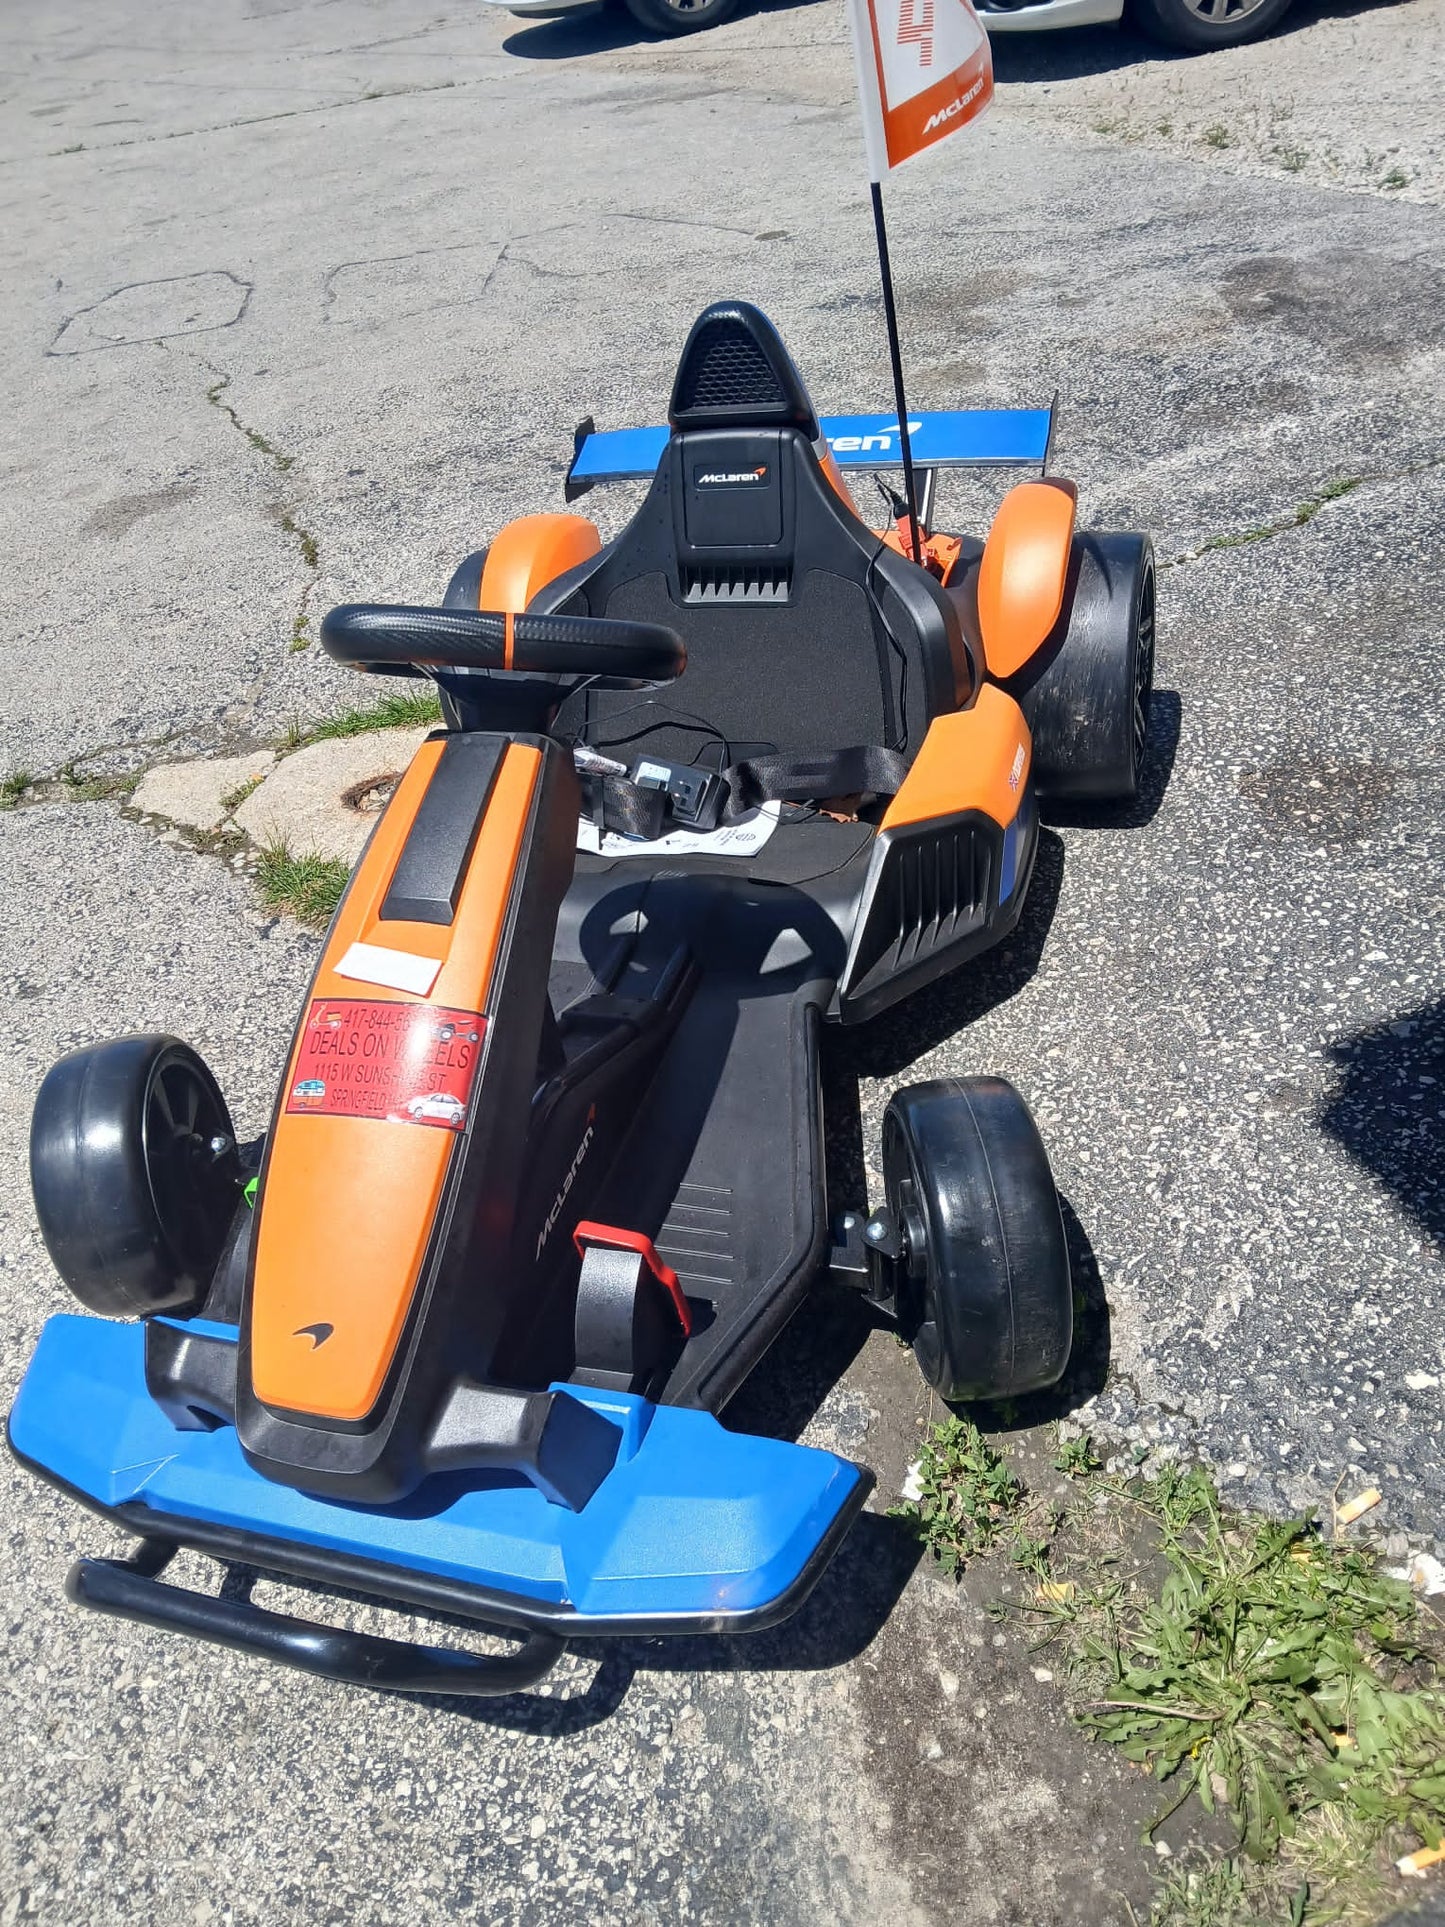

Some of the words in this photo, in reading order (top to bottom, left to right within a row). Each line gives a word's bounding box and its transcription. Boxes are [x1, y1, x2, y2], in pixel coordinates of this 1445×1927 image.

[922, 78, 985, 136] McLaren
[698, 473, 759, 484] McLaren
[309, 1031, 359, 1056] DEALS
[363, 1033, 388, 1058] ON
[341, 1065, 355, 1082] W
[427, 1072, 447, 1092] ST
[536, 1125, 595, 1262] McLaren
